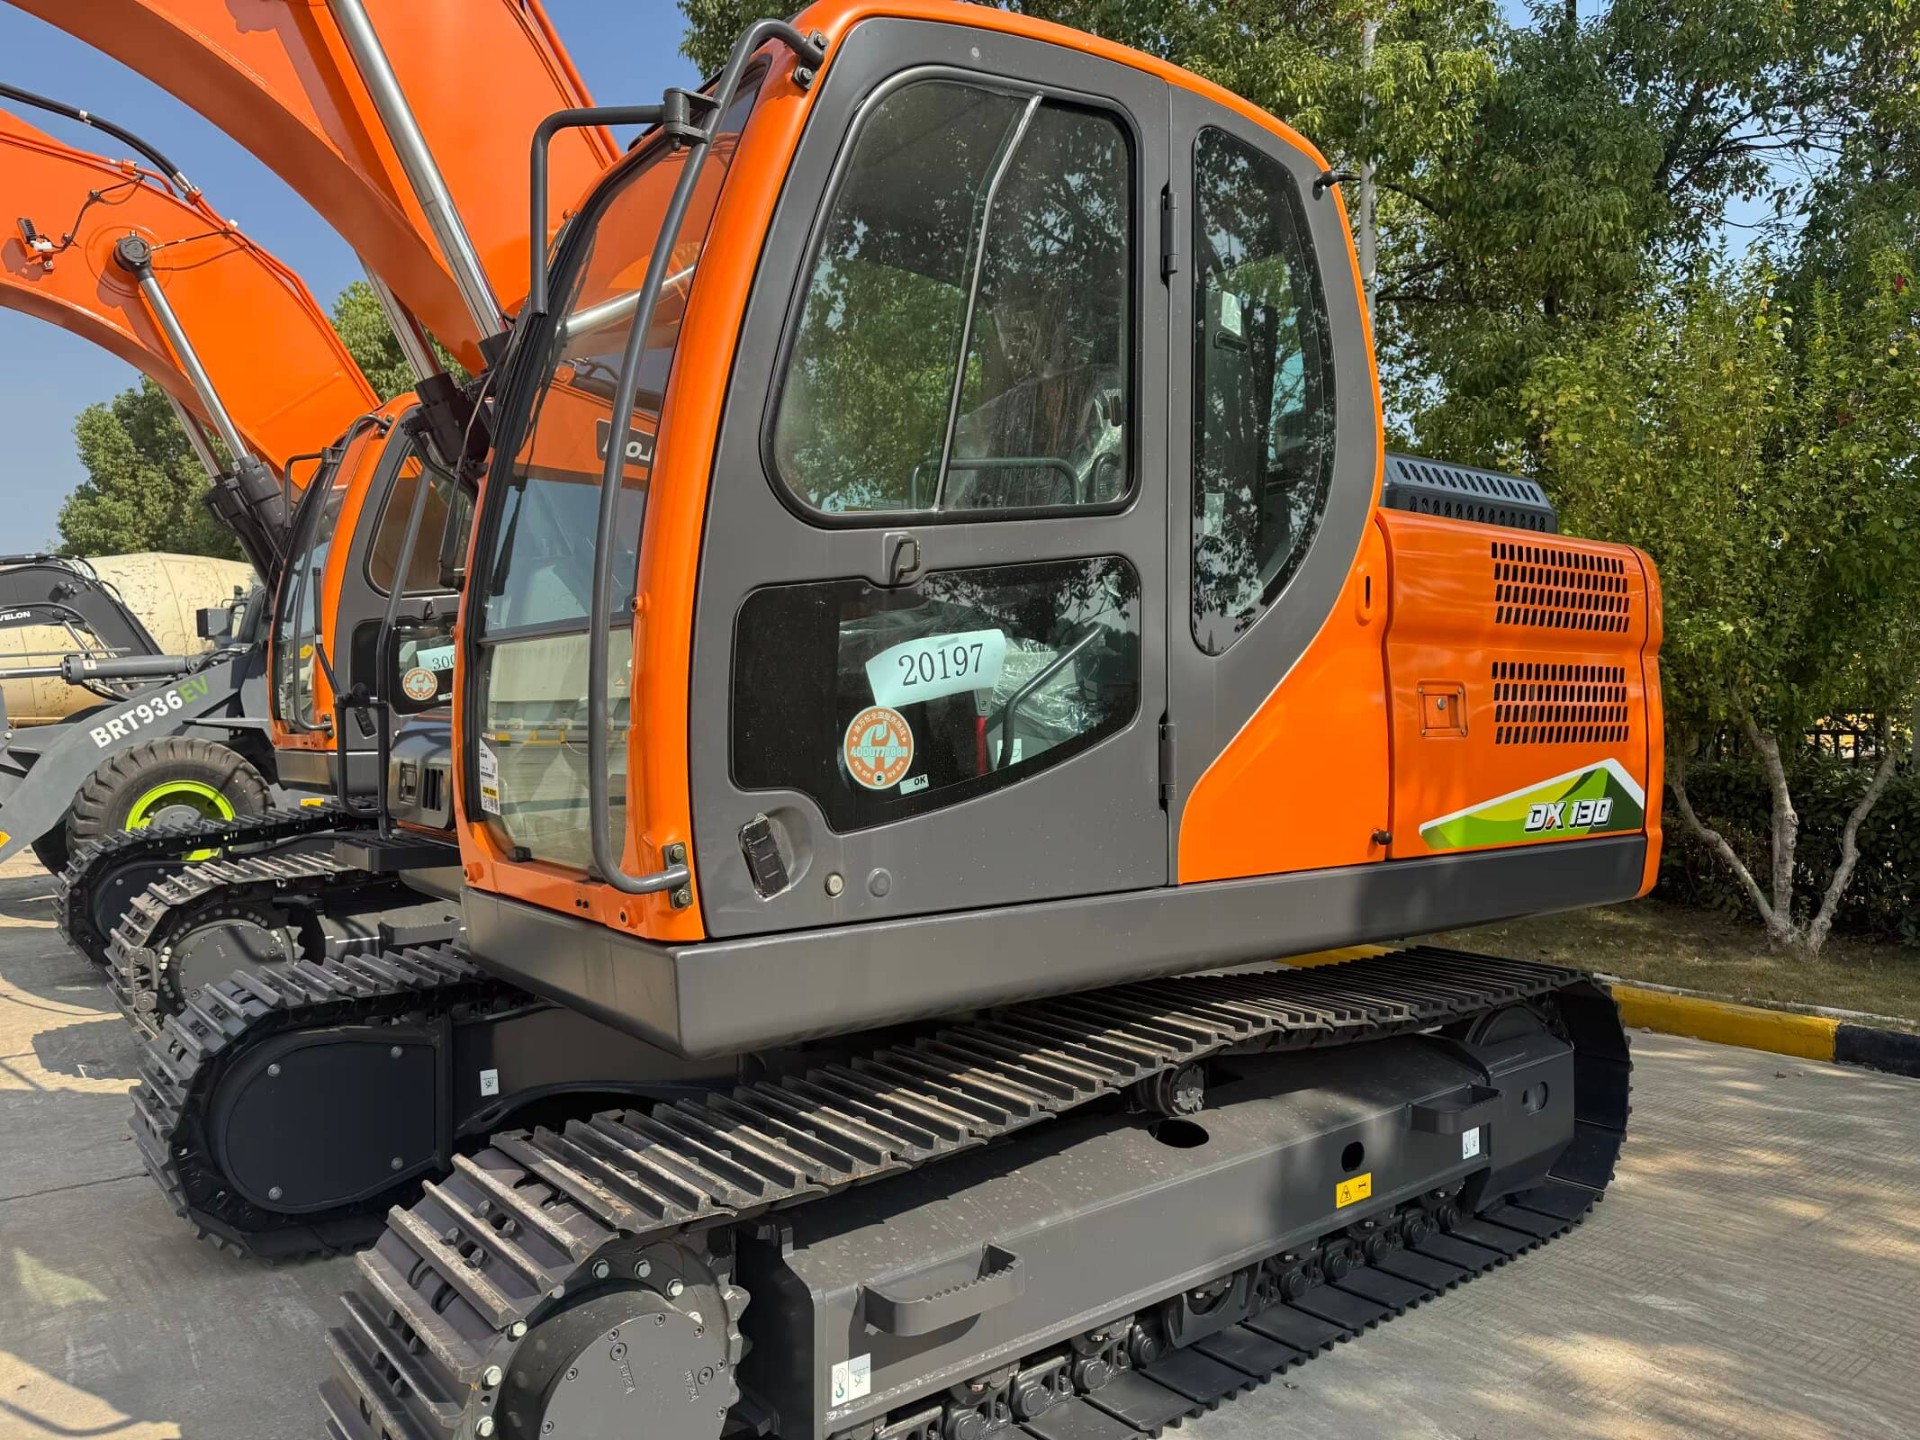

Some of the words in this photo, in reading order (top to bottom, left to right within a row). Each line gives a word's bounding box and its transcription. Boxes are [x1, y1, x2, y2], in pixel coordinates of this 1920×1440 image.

[899, 644, 984, 686] 20197
[89, 675, 209, 749] BRT936EV
[914, 775, 927, 786] OK
[1524, 801, 1566, 831] DX
[1569, 797, 1613, 828] 130
